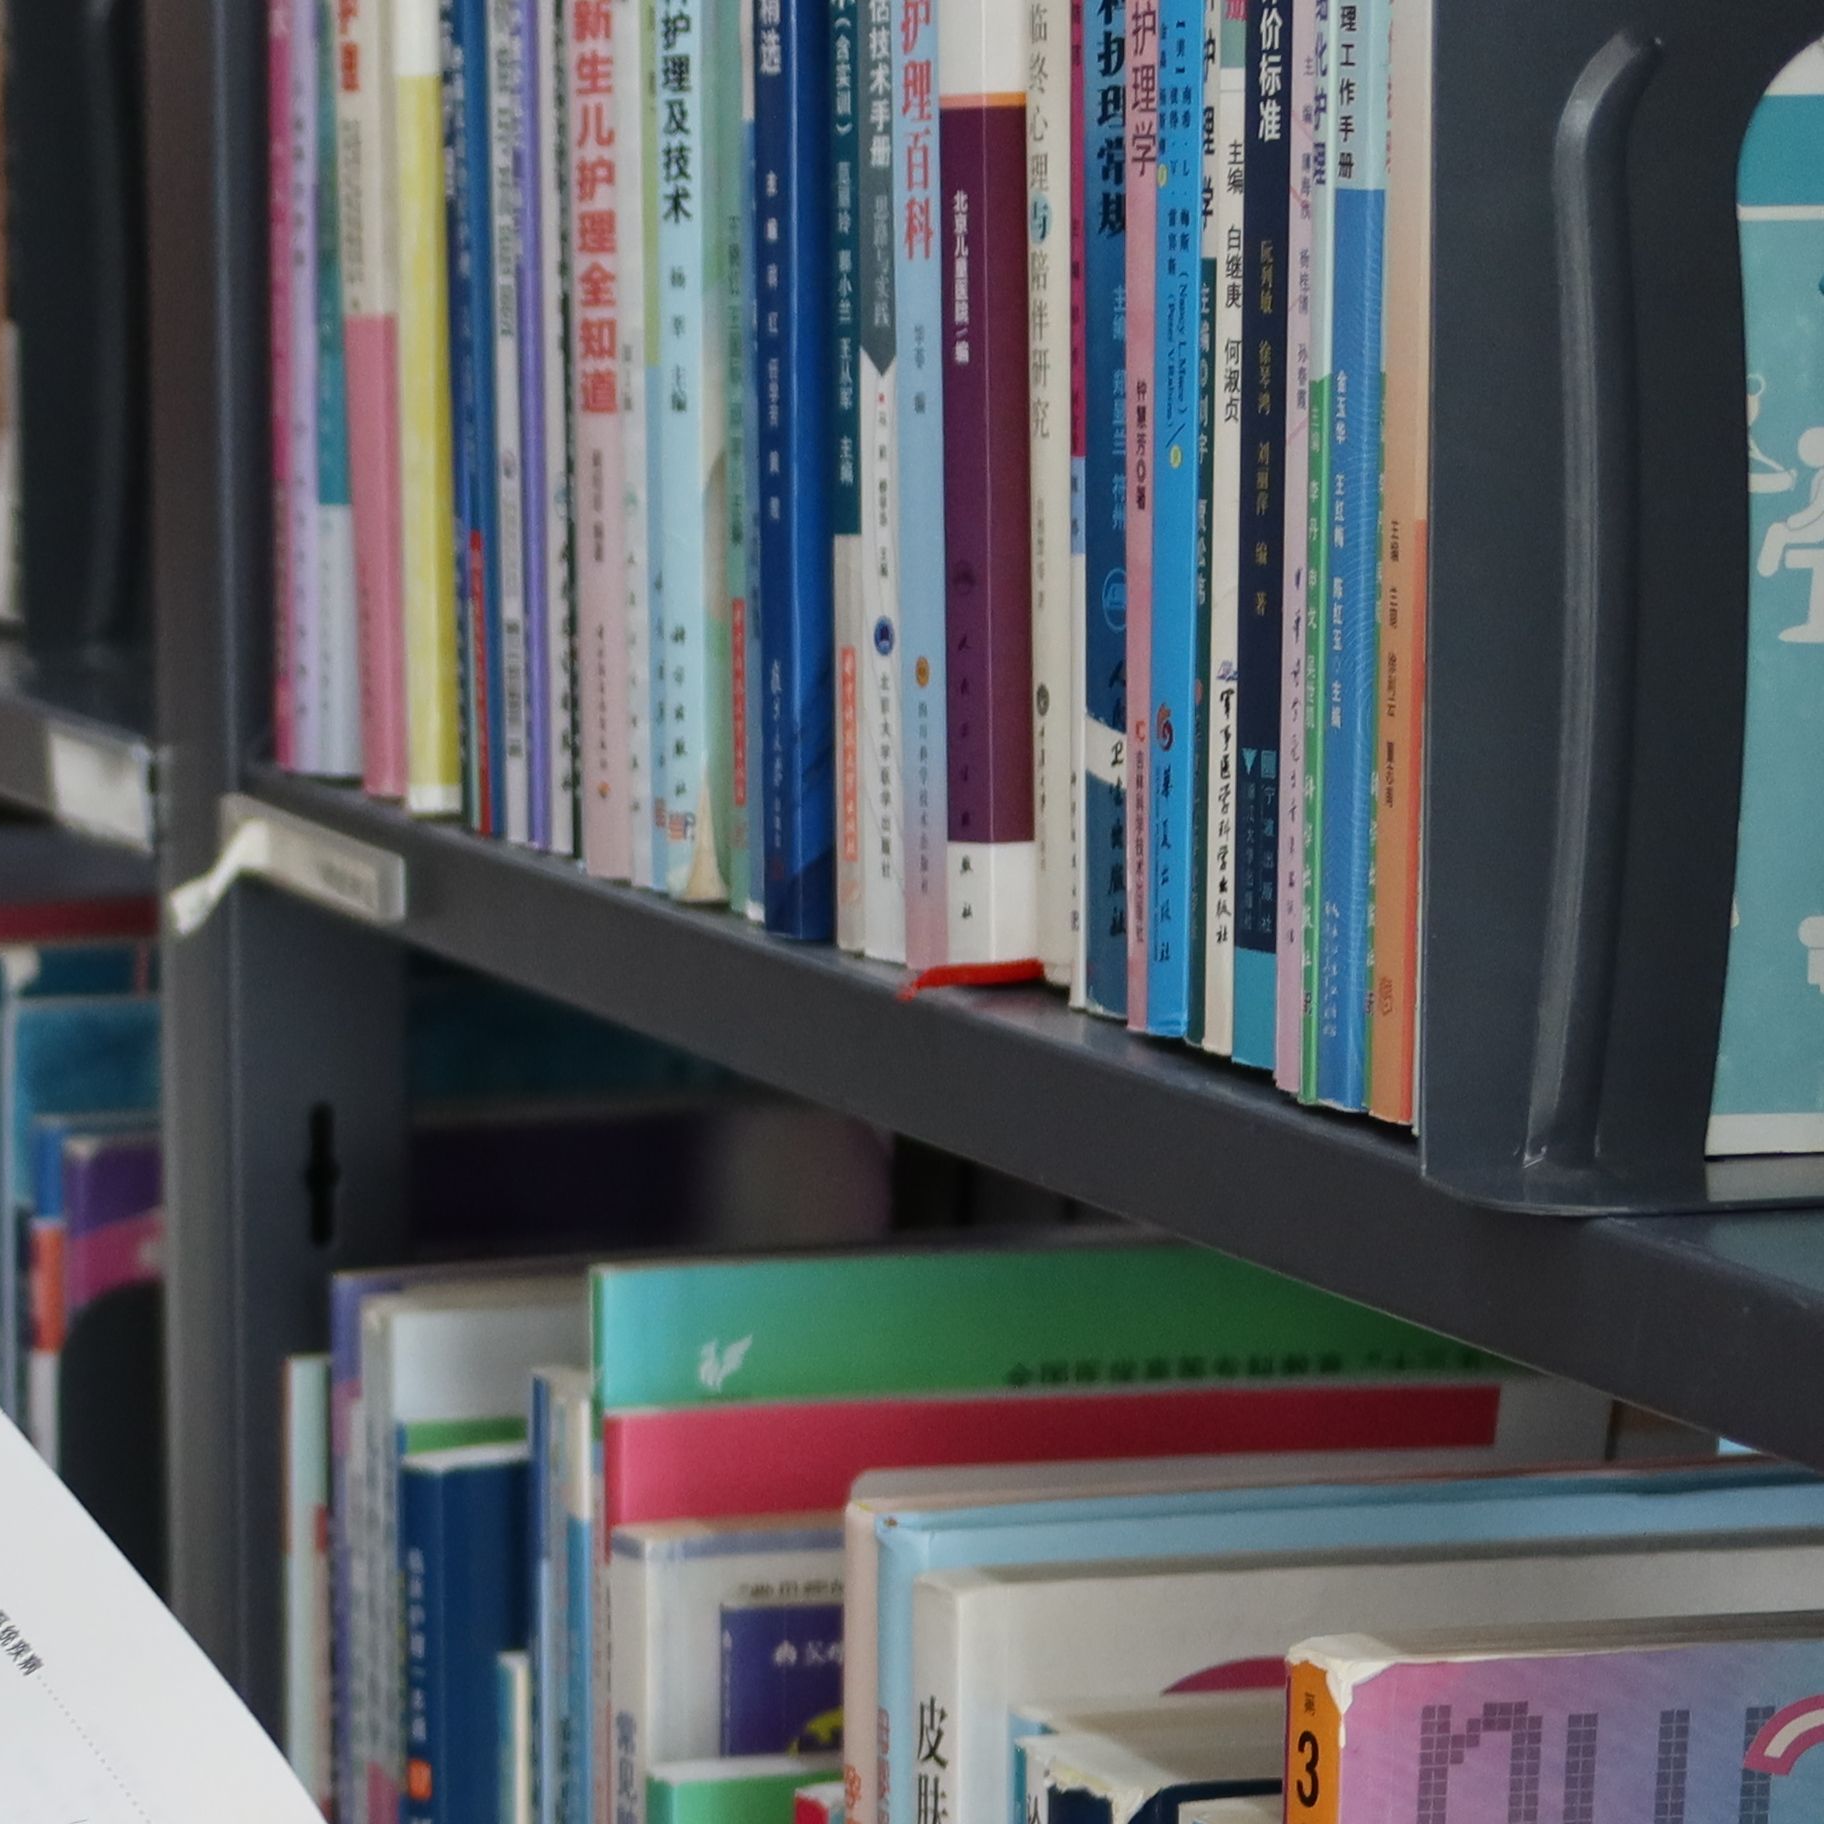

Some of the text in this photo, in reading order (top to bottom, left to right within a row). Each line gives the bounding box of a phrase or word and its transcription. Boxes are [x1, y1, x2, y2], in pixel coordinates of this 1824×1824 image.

[661, 0, 693, 224] 护理及技术
[900, 0, 934, 262] 护理百科
[1131, 8, 1157, 178] 护理学
[1257, 0, 1283, 142] 价标准
[1336, 2, 1358, 181] 理工作手册
[573, 0, 618, 414] 新生儿护理全知道
[1028, 4, 1052, 440] 临终心理与陪伴研究
[1223, 139, 1245, 423] 主编 白继庚 何淑贞
